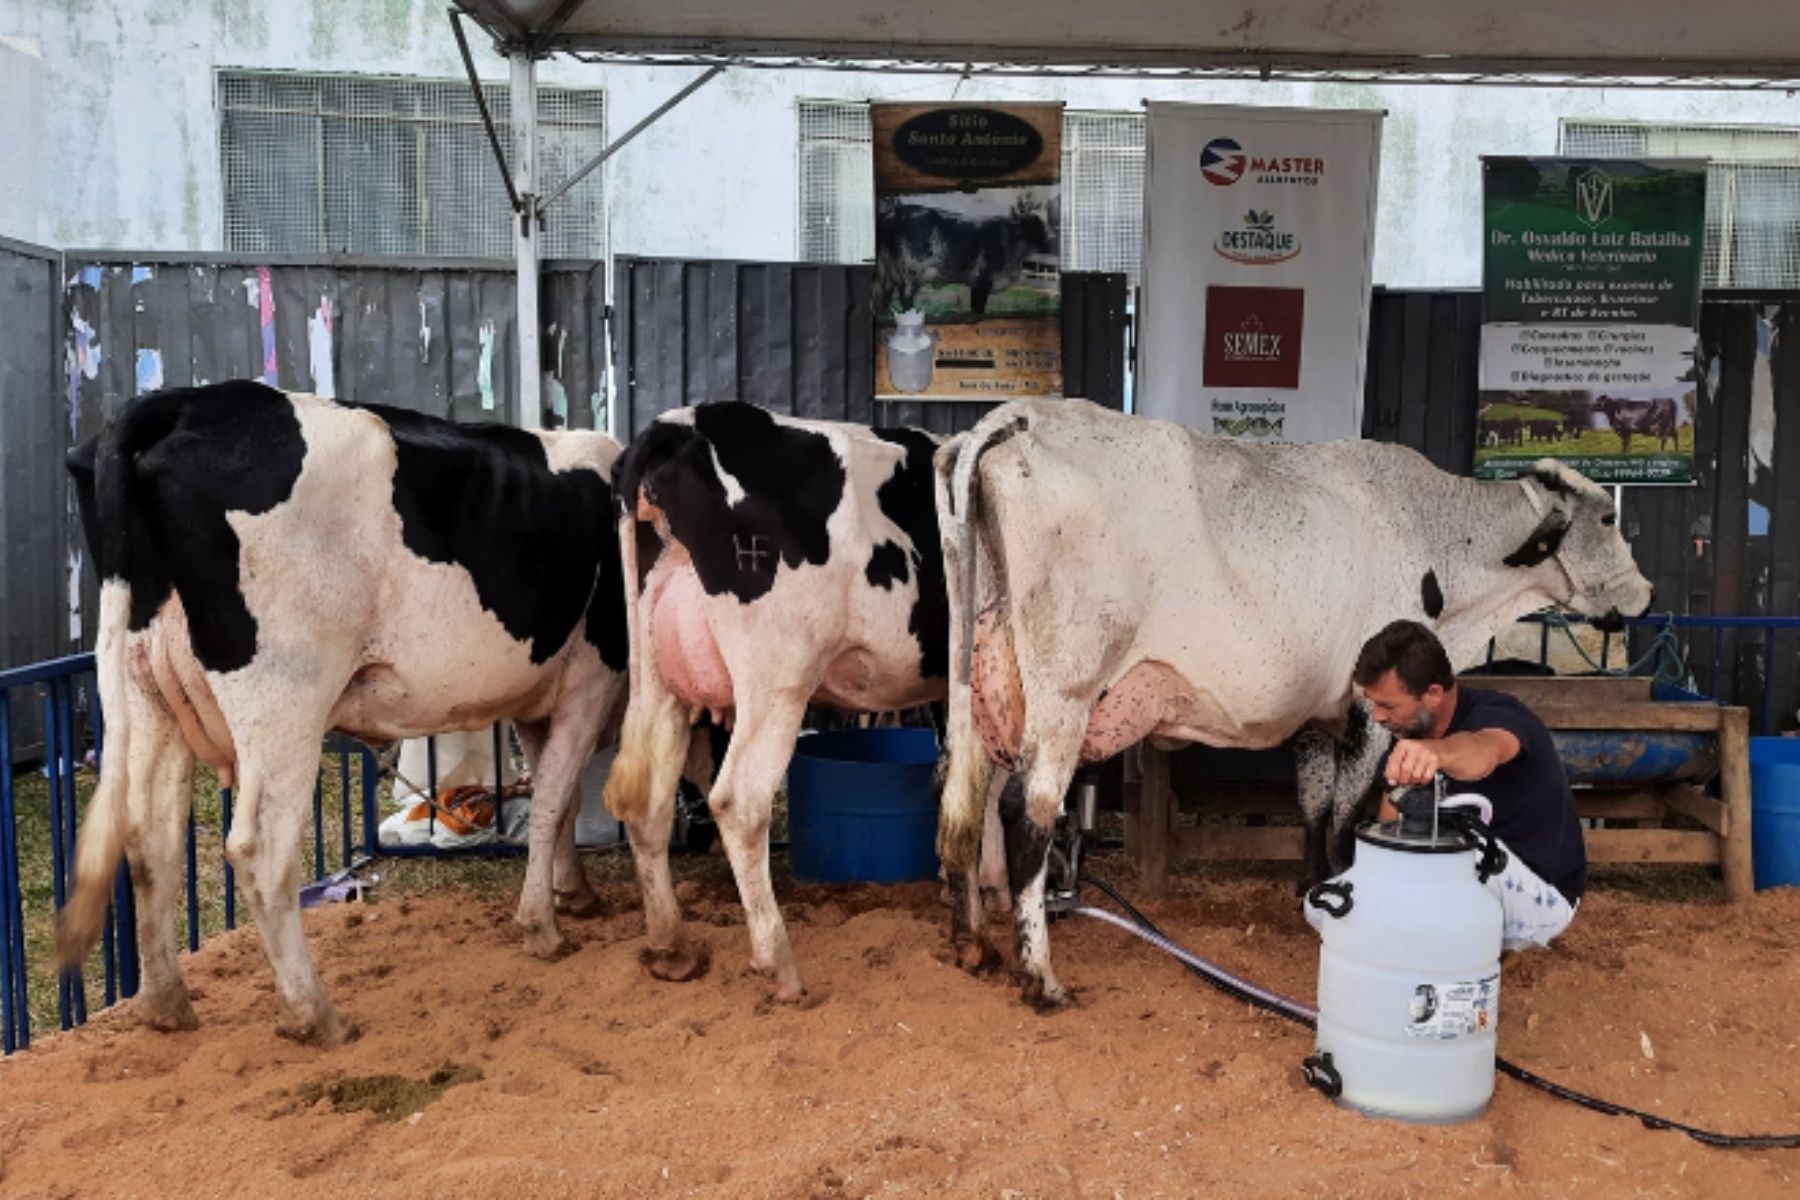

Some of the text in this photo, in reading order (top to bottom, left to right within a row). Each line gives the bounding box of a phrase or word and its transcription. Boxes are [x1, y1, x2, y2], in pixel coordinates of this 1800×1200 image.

[1250, 157, 1324, 175] MASTER
[1222, 231, 1293, 251] DESTAQUE
[1491, 230, 1691, 247] Dr. Osvaldo Luiz Batalha
[1224, 332, 1282, 356] SEMEX
